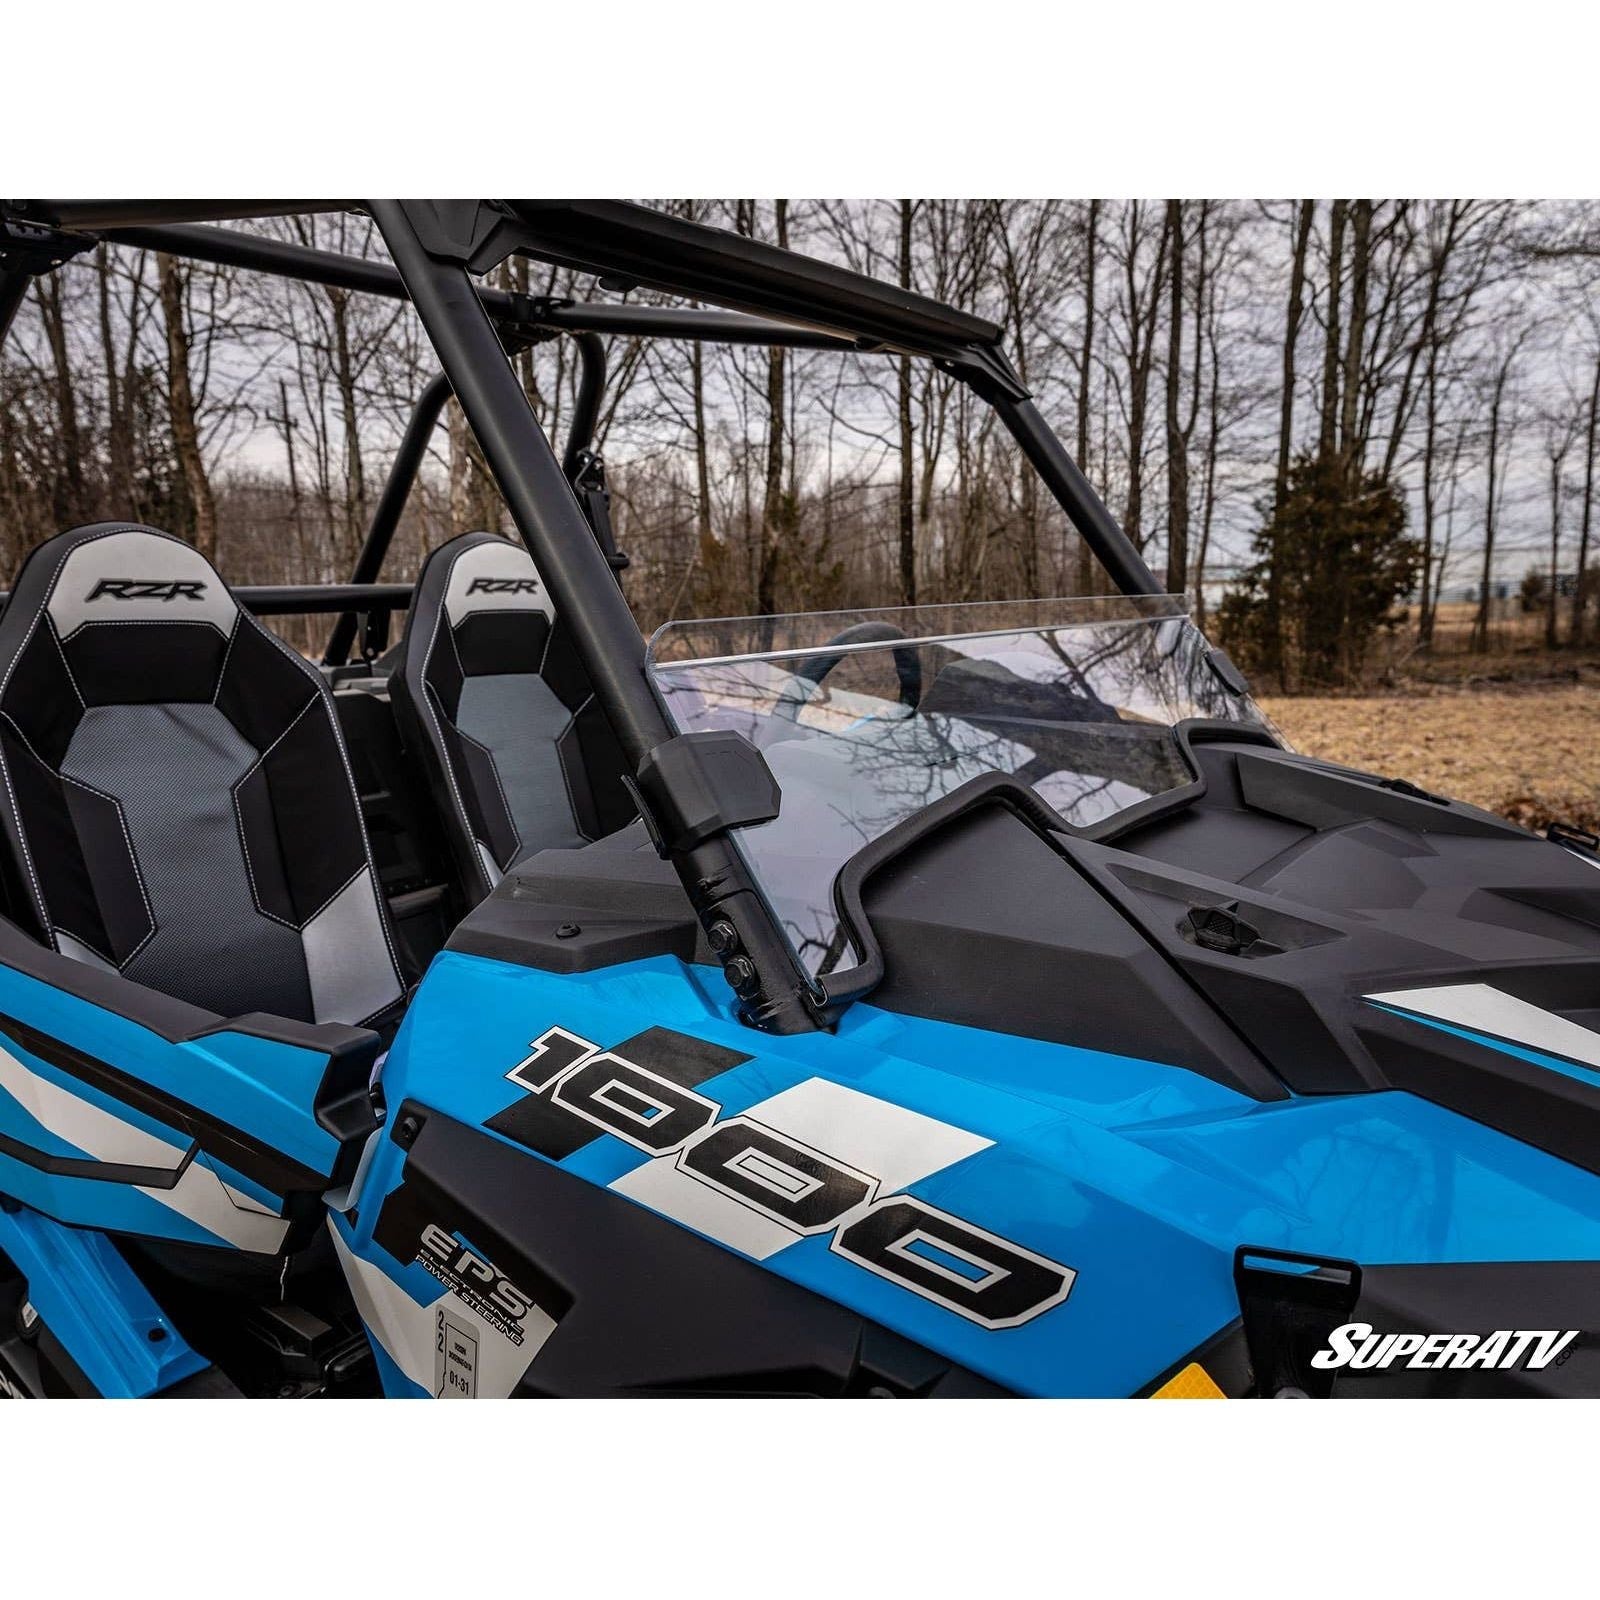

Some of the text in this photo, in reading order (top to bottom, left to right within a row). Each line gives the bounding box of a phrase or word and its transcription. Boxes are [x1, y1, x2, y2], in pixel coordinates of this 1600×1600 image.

[85, 579, 207, 602] RZR
[466, 577, 538, 596] RZR
[504, 1025, 1077, 1331] 1000
[415, 1254, 523, 1345] POWER STEERING
[419, 1248, 524, 1334] ELECTRONIC
[420, 1223, 534, 1318] EPS
[449, 1370, 470, 1396] 01-31
